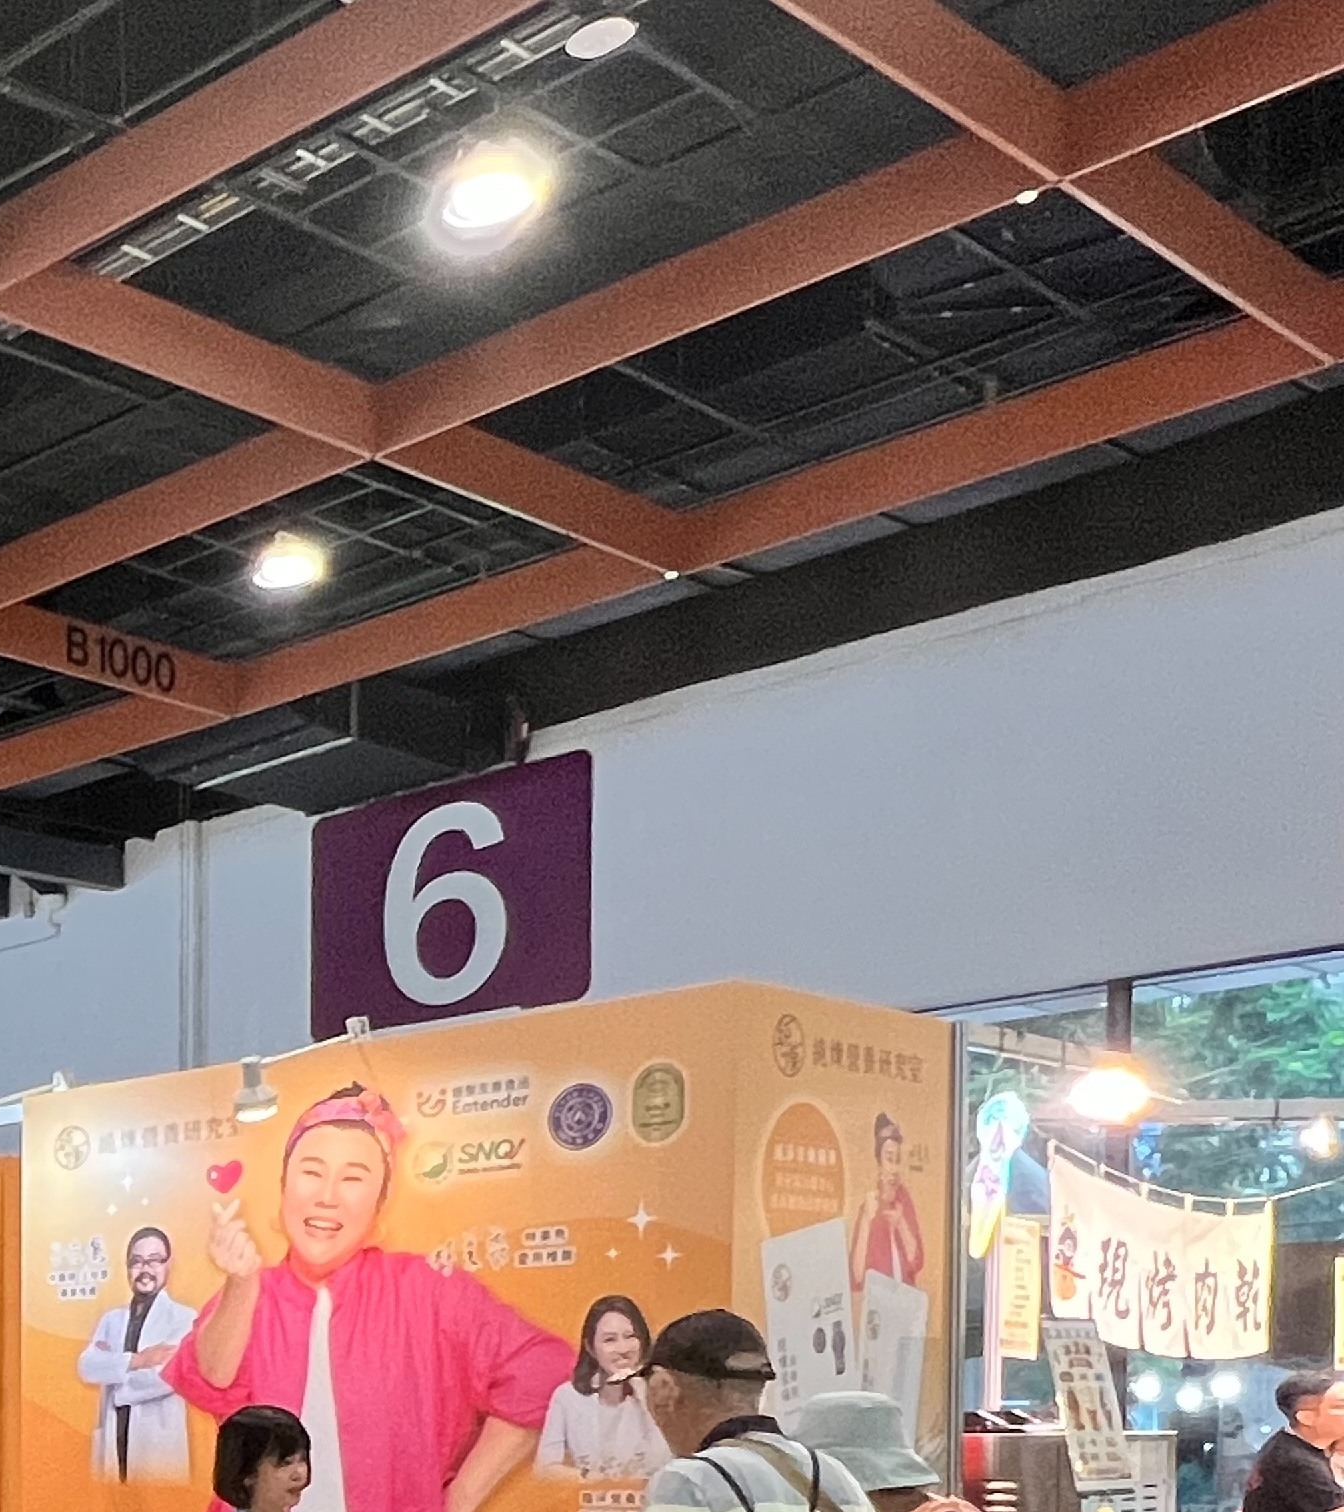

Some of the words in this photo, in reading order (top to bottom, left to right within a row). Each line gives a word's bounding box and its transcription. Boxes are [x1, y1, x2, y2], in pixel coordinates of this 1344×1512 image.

[66, 624, 176, 692] B1000
[383, 800, 508, 1006] 6
[452, 1093, 530, 1116] Eatender
